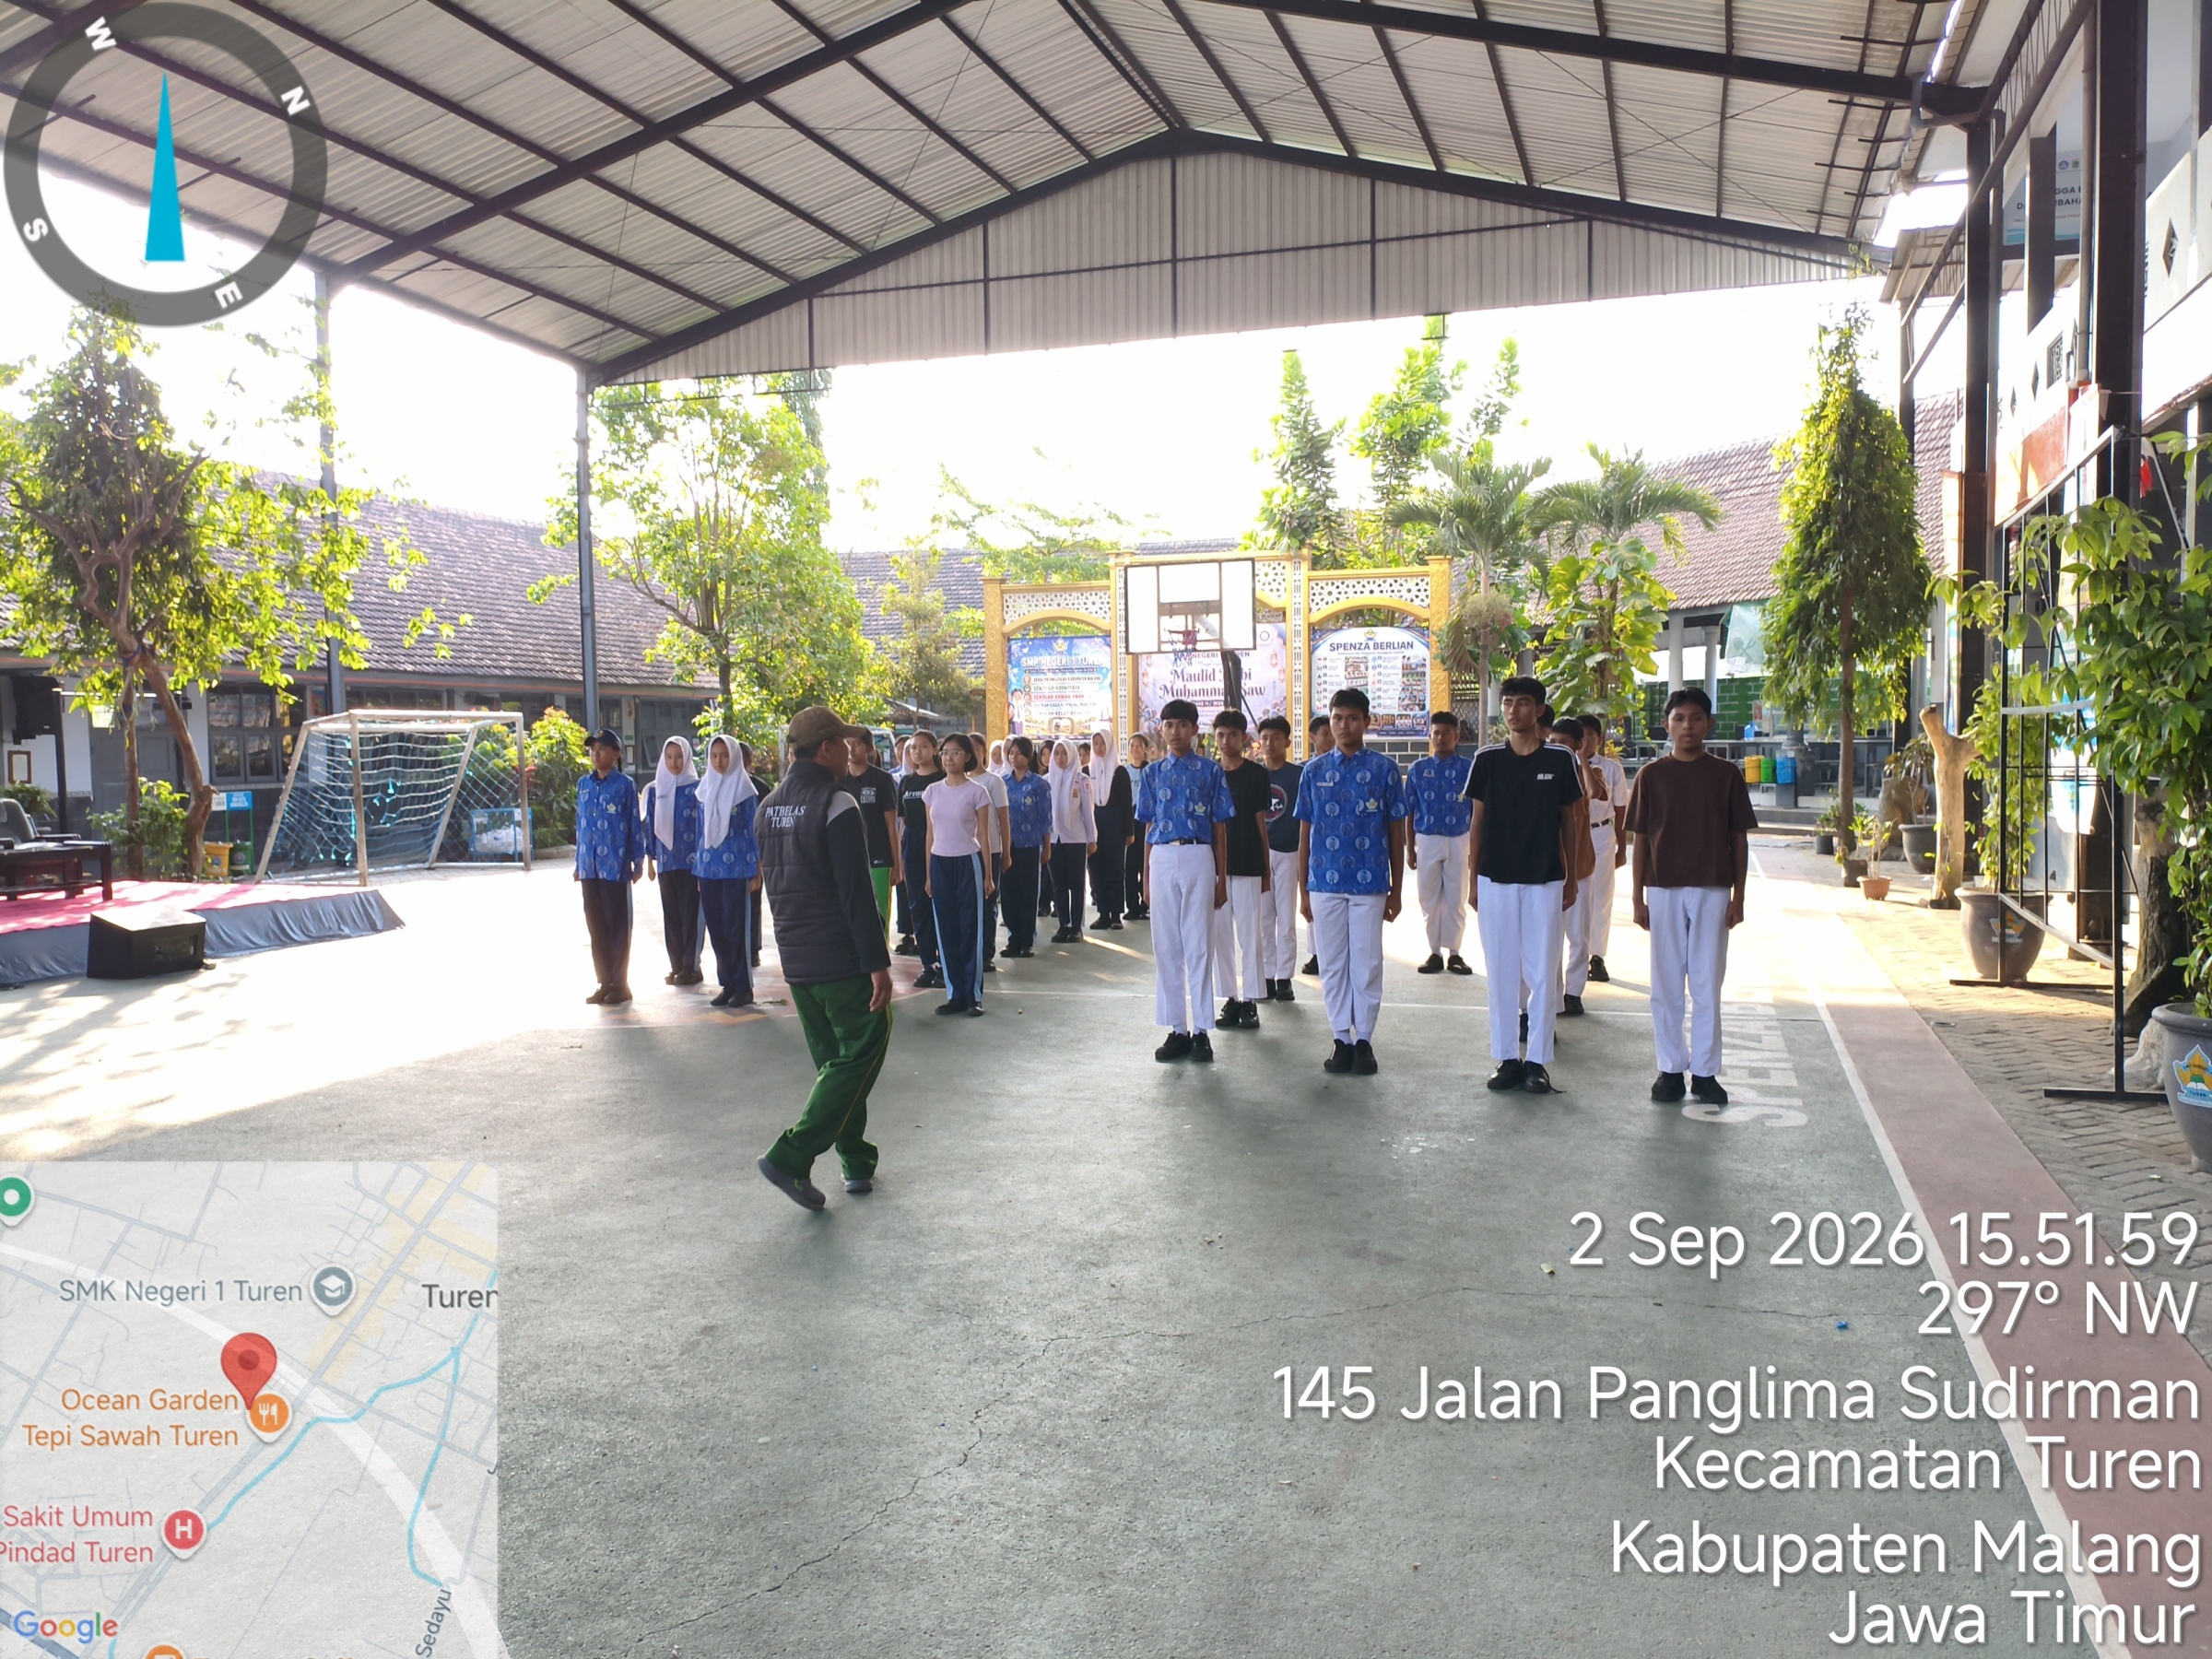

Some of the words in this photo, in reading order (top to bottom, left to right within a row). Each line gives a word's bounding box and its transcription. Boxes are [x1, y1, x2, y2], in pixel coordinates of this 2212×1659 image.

[1329, 642, 1371, 652] SPENZA
[1373, 641, 1414, 651] BERLIAN
[1021, 657, 1039, 668] SMP
[1041, 656, 1069, 667] NEGERI
[1170, 668, 1216, 684] Maulid
[1159, 683, 1224, 700] Muhamma
[765, 806, 806, 818] PATBELAS
[771, 816, 794, 829] TUREN
